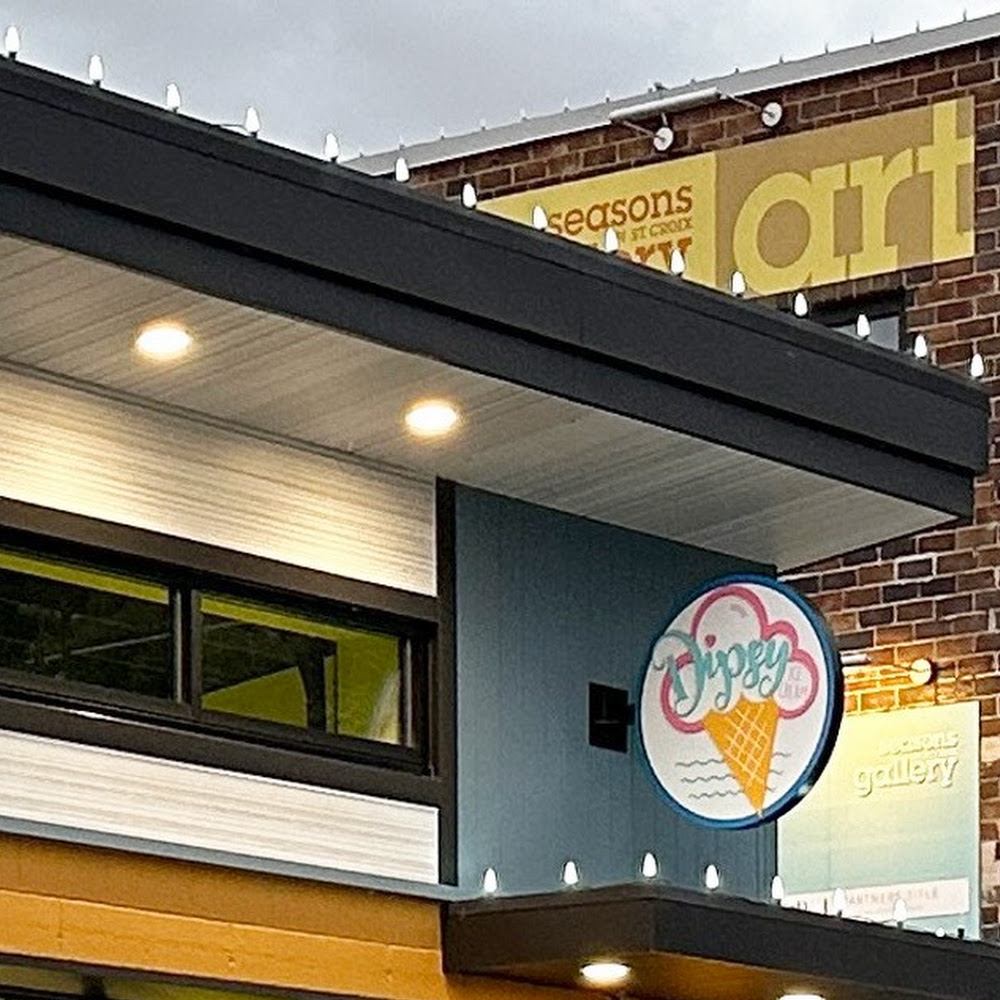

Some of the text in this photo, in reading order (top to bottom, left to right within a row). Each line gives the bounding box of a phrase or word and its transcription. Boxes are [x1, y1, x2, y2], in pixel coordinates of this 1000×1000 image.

[548, 184, 693, 236] seasons
[733, 95, 975, 296] art
[653, 629, 789, 718] Dipsy
[853, 757, 960, 799] gallery
